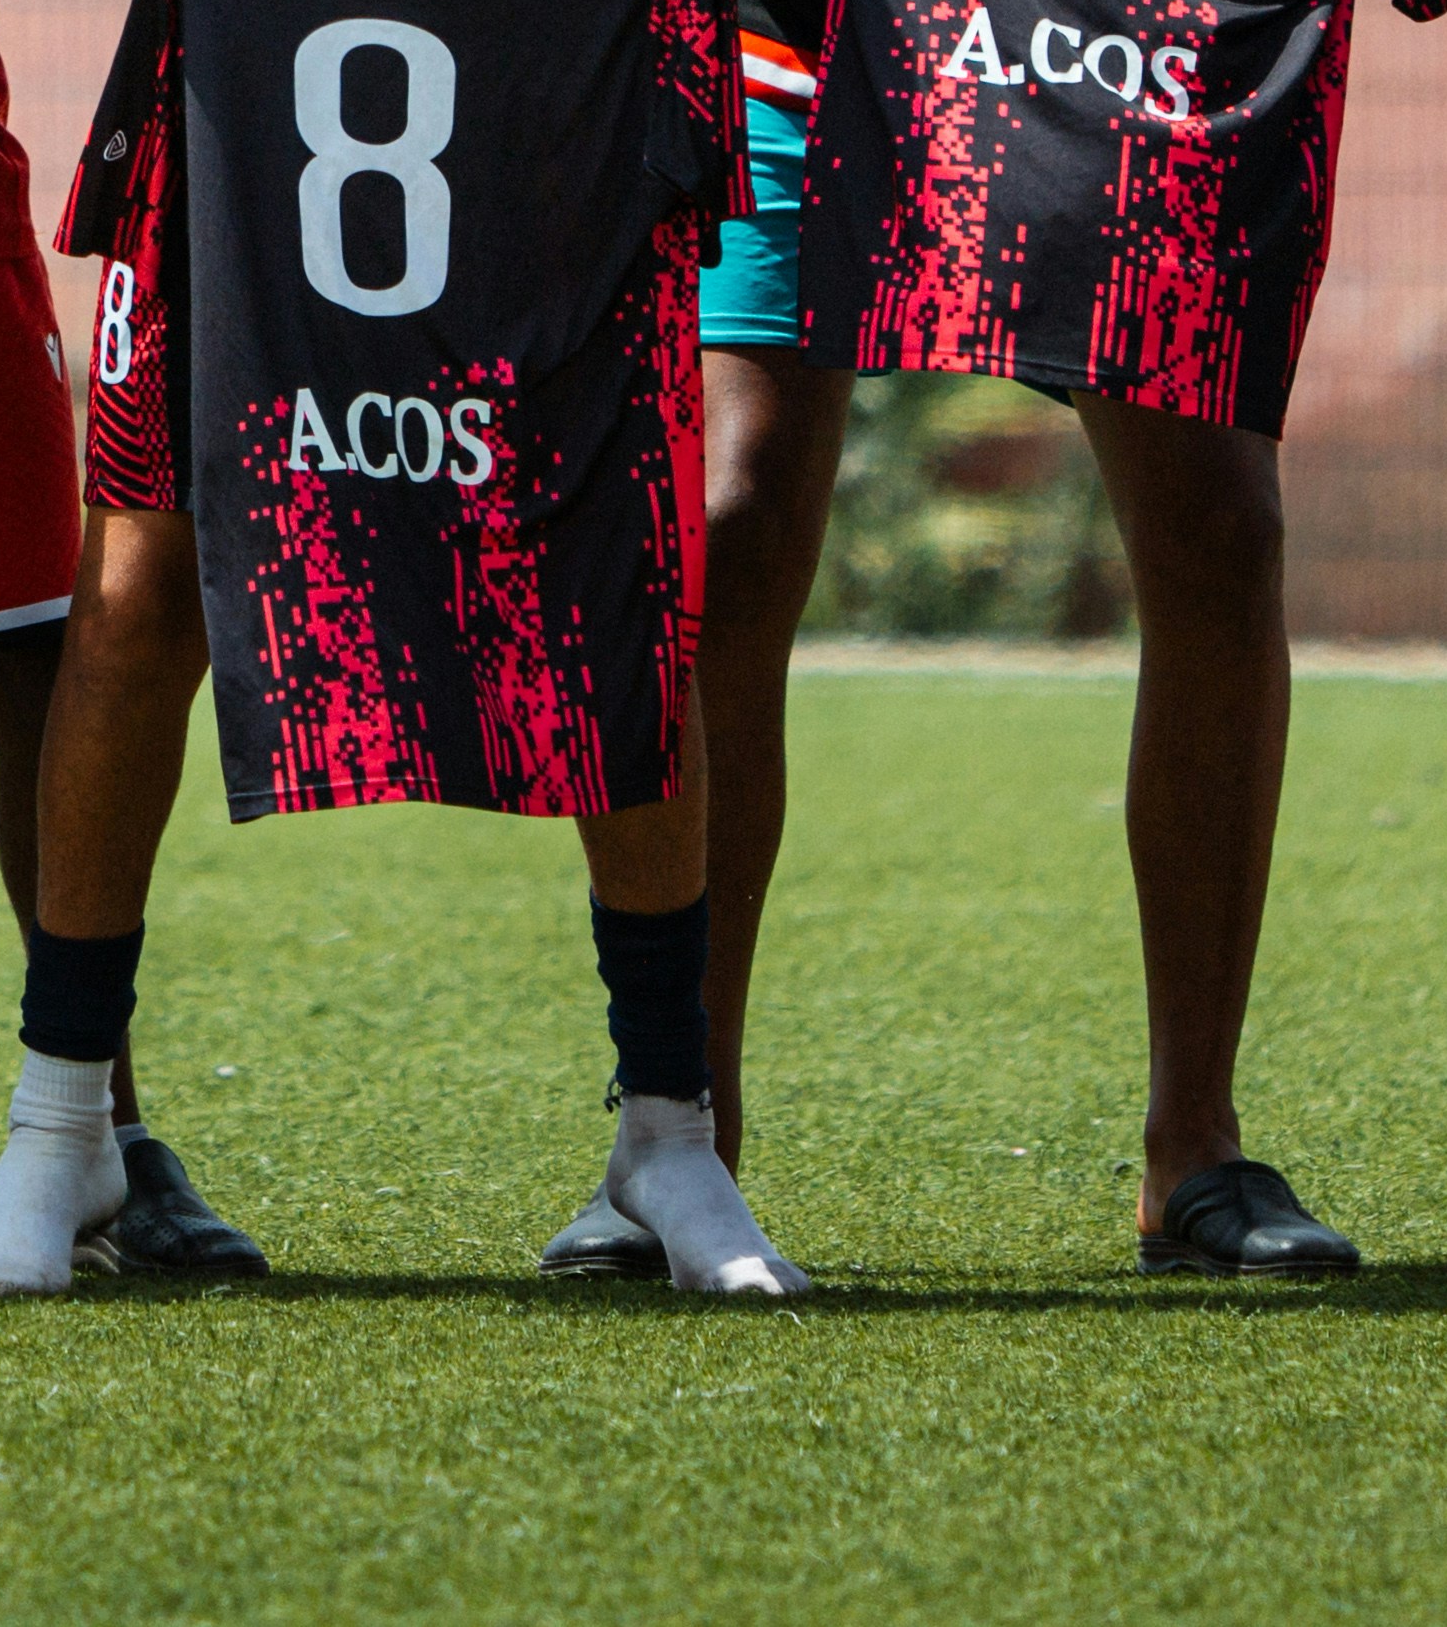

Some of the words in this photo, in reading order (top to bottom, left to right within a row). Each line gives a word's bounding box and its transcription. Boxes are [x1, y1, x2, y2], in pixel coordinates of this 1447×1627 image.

[938, 6, 1199, 123] A.COS
[293, 18, 457, 317] 8
[98, 260, 135, 385] 8
[287, 387, 494, 487] A.COS
